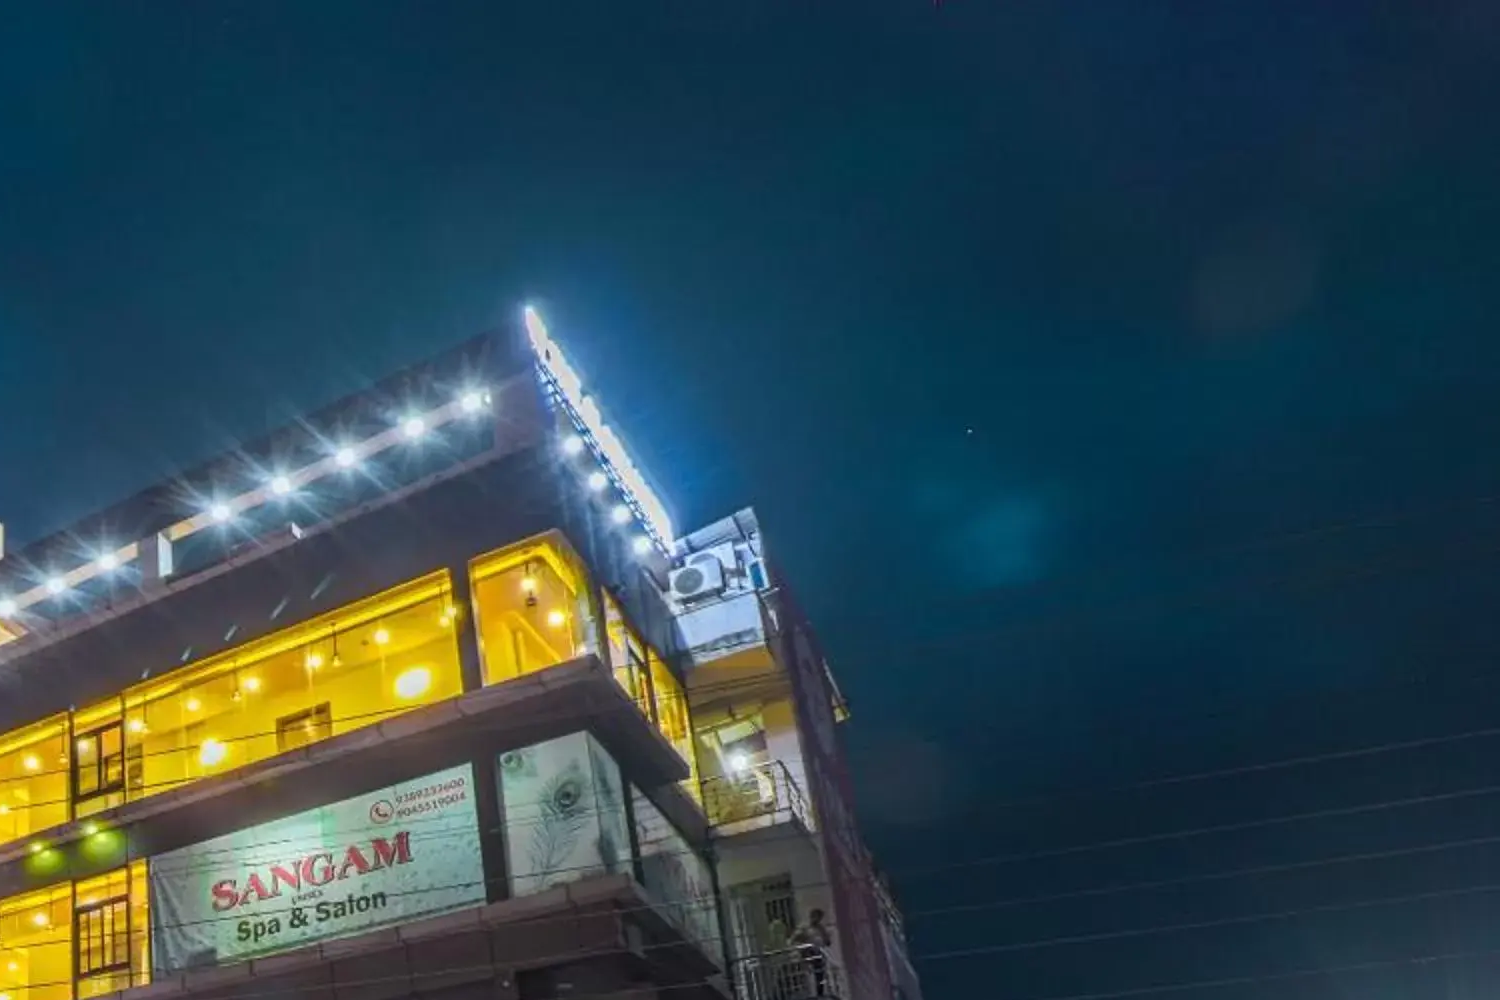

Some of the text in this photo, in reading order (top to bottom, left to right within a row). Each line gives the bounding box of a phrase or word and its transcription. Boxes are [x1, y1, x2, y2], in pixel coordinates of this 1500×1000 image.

[211, 831, 414, 912] SANGAM
[236, 890, 387, 944] Spa & Salon
